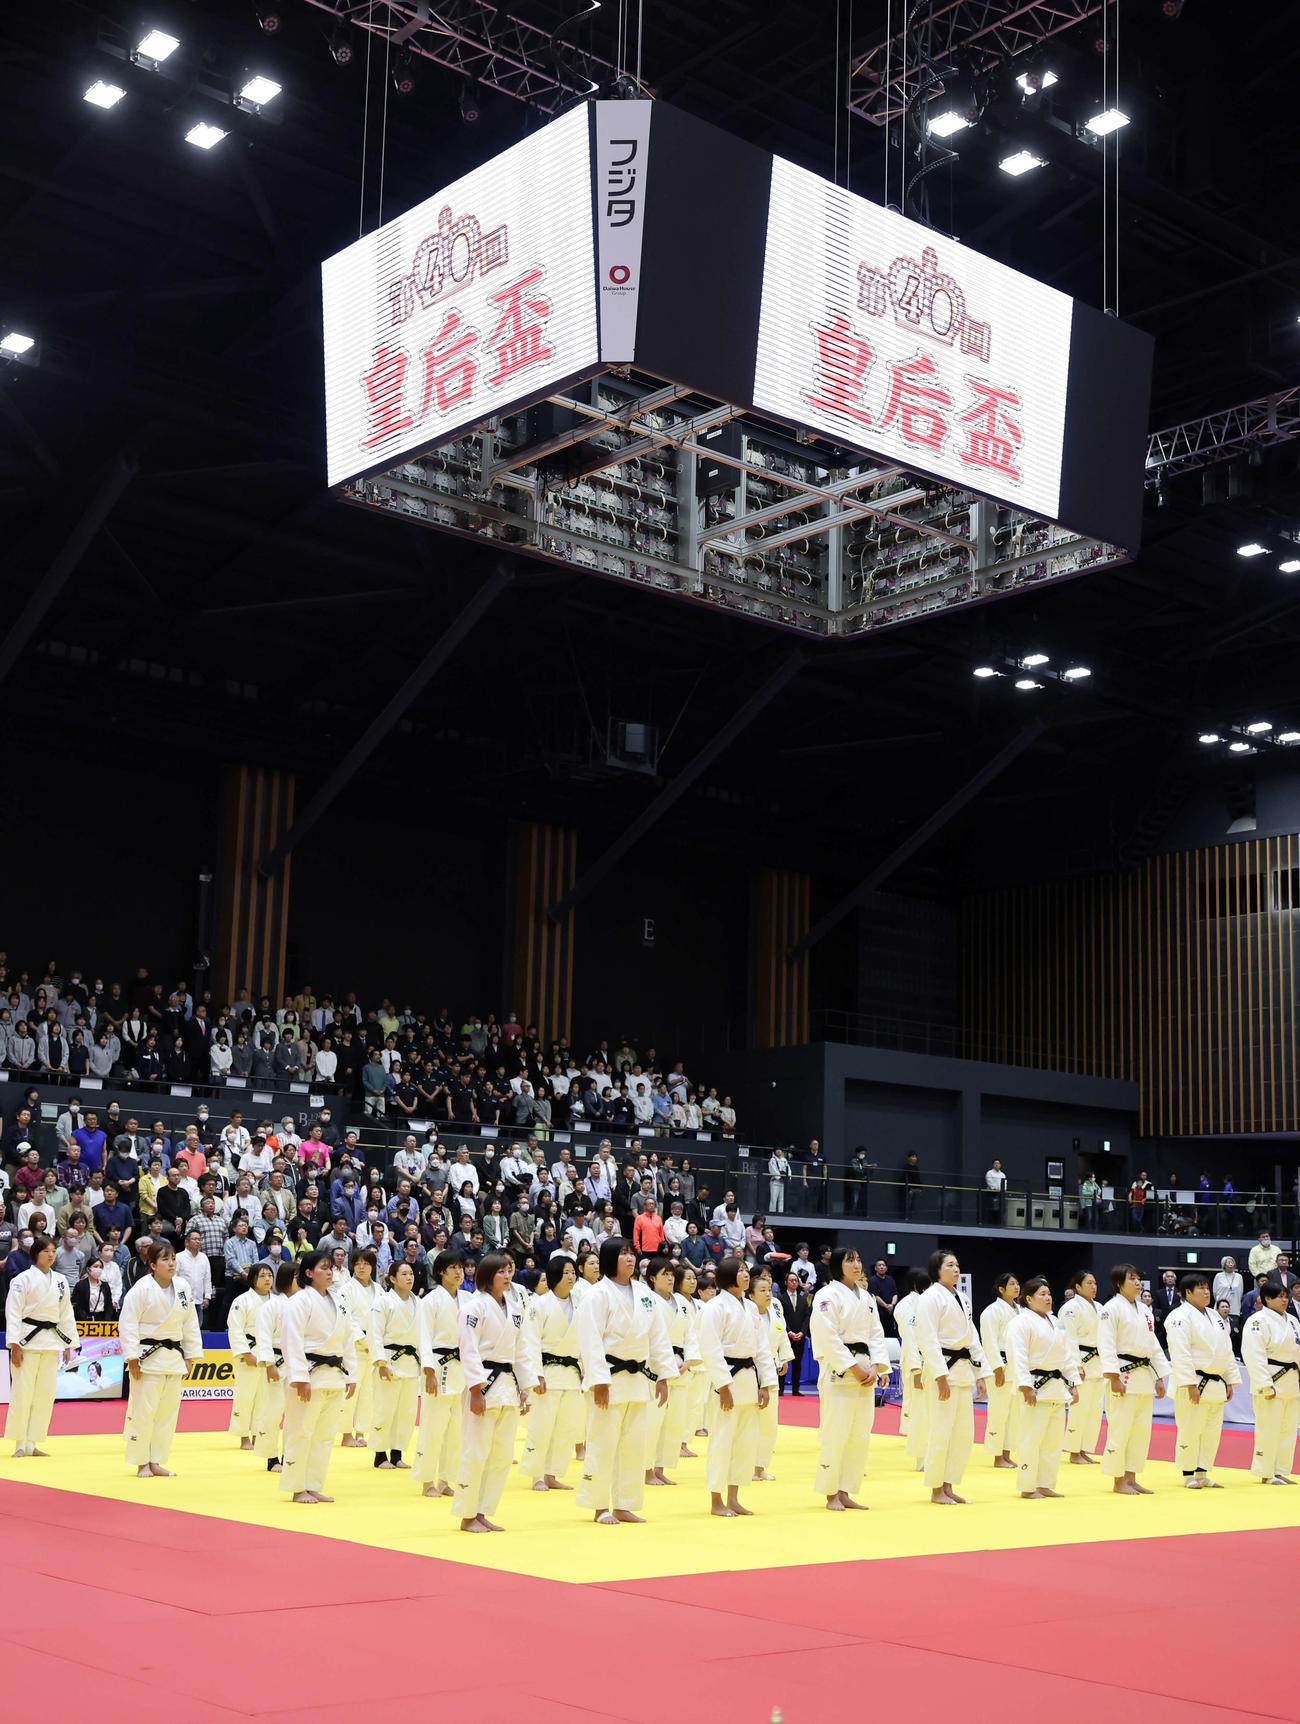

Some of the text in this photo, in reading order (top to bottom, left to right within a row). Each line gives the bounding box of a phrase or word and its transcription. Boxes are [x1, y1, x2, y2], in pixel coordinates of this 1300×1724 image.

[606, 139, 638, 227] フジタ
[361, 265, 553, 450] 皇后盃
[803, 311, 1023, 484] 皇后盃
[643, 918, 655, 940] E
[181, 1389, 212, 1397] ARK24
